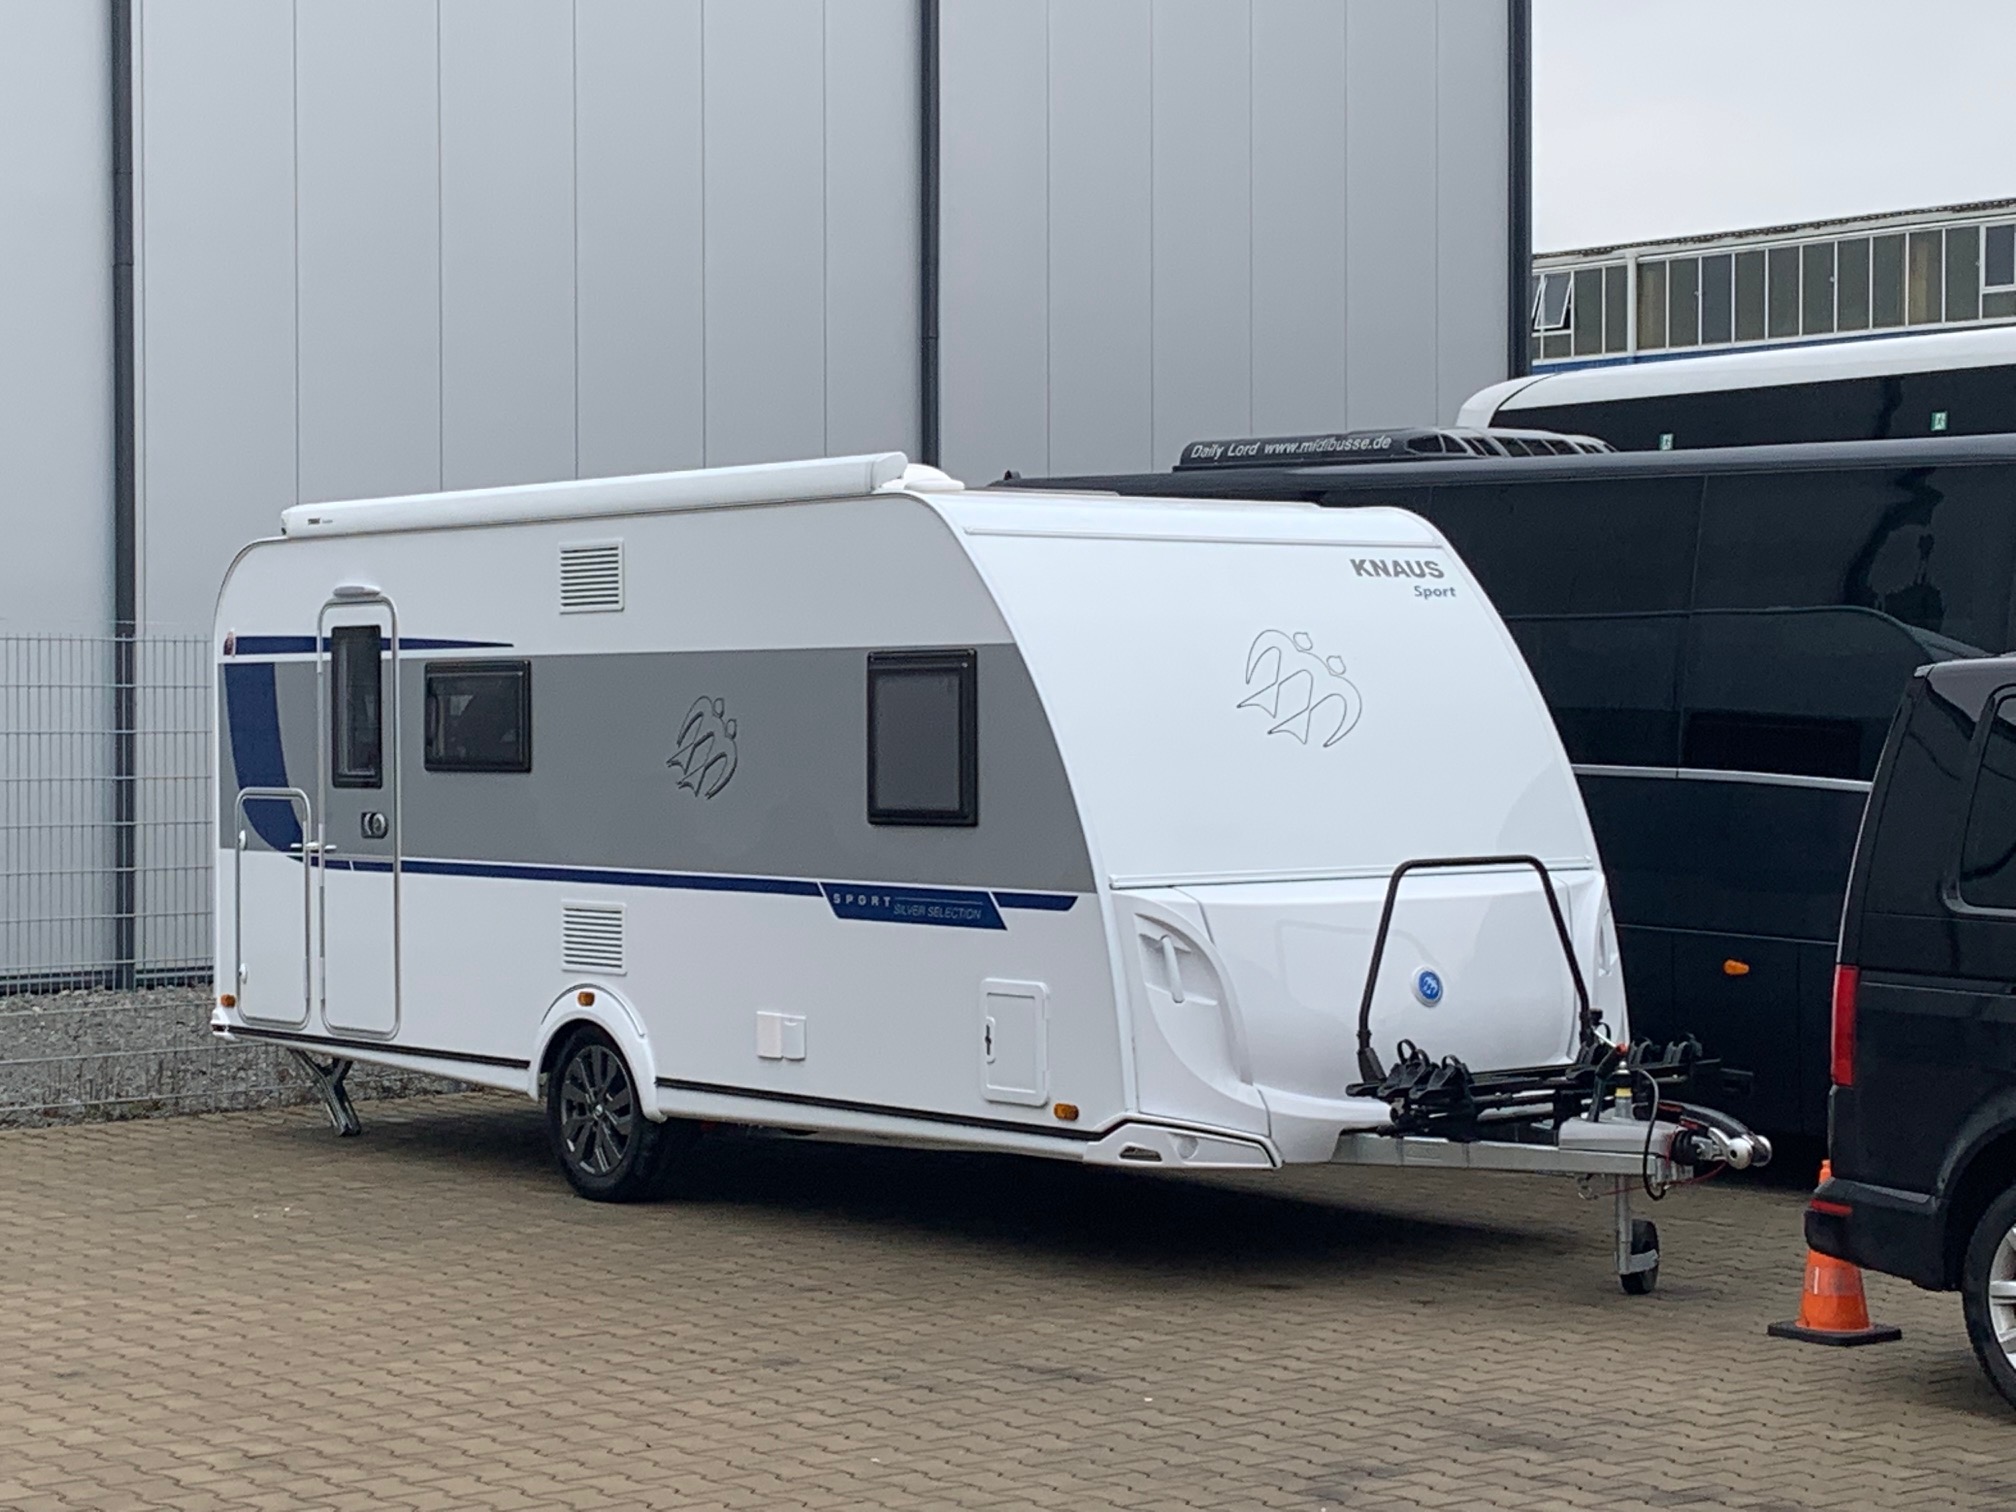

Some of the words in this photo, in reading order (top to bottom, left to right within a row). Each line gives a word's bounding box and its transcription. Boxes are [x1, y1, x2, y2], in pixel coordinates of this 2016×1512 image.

[1191, 444, 1224, 458] Daily
[1227, 442, 1260, 456] Lord
[1264, 435, 1391, 454] www.midibusse.de
[1350, 559, 1444, 578] KNAUS
[1414, 585, 1456, 600] Sport
[833, 893, 891, 907] SPORT
[893, 904, 925, 916] SILVER
[927, 906, 982, 919] SELECTION
